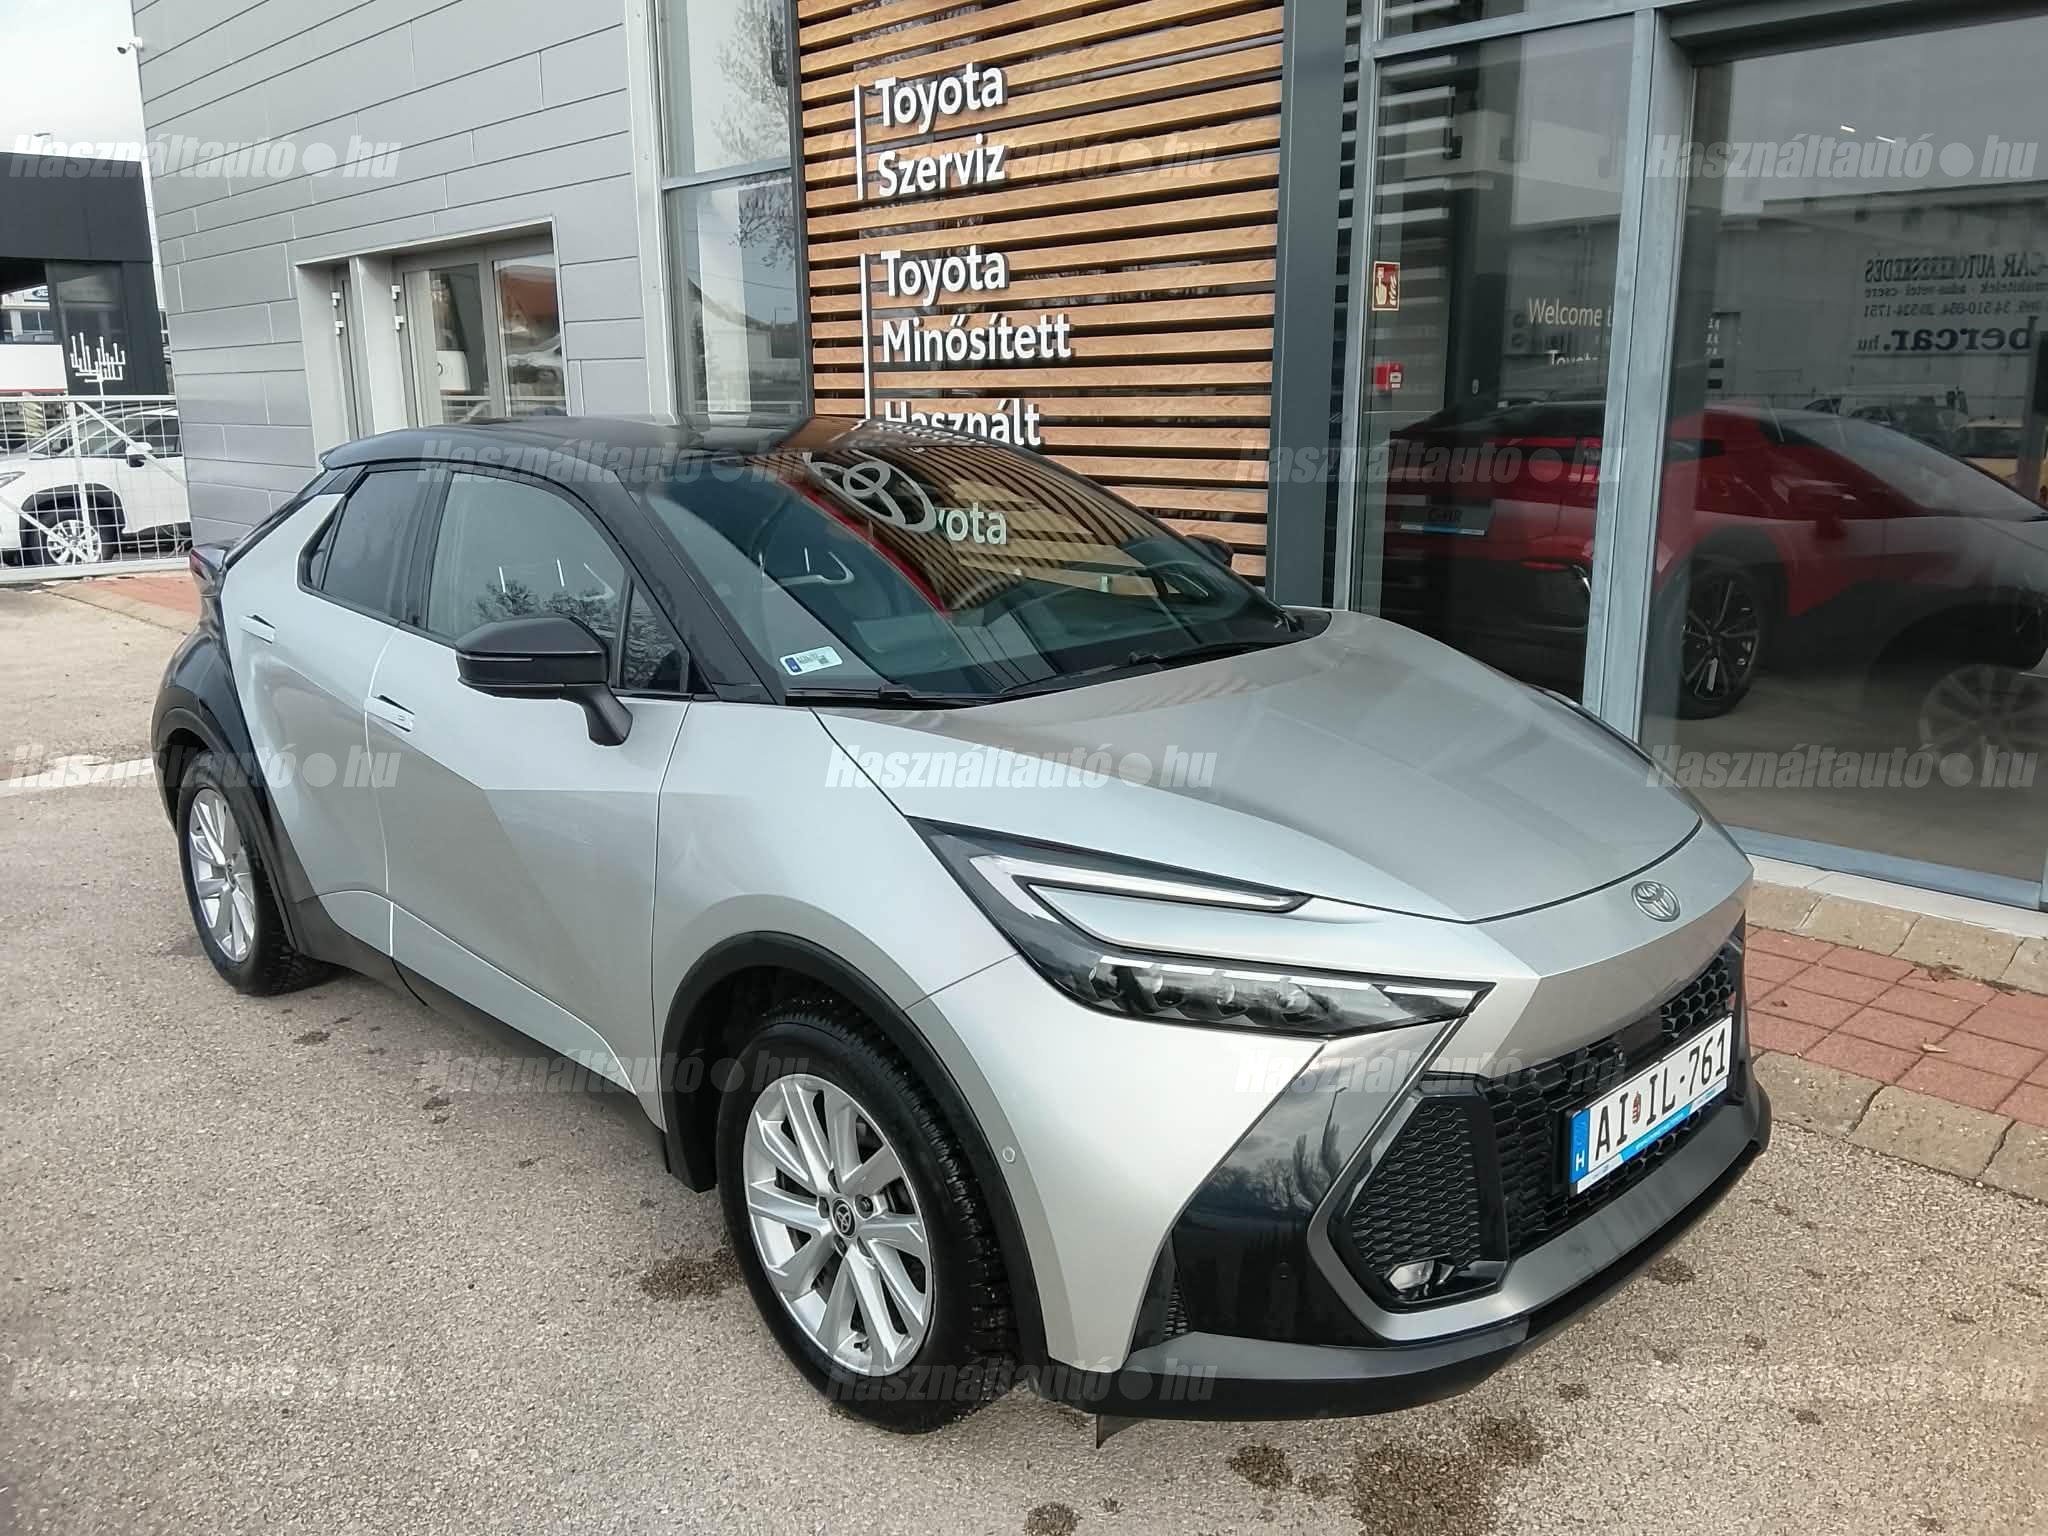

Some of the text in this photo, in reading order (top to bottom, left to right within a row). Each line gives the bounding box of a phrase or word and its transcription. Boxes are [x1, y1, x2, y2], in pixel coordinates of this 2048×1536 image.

[876, 62, 1004, 133] Toyota
[878, 135, 1006, 197] Szerviz
[881, 246, 1007, 306] Toyota
[882, 313, 1071, 363] Minősített
[1528, 297, 1604, 327] Welcome
[1546, 349, 1600, 367] Toyt
[1595, 1092, 1629, 1161] AI
[1575, 1150, 1586, 1172] H
